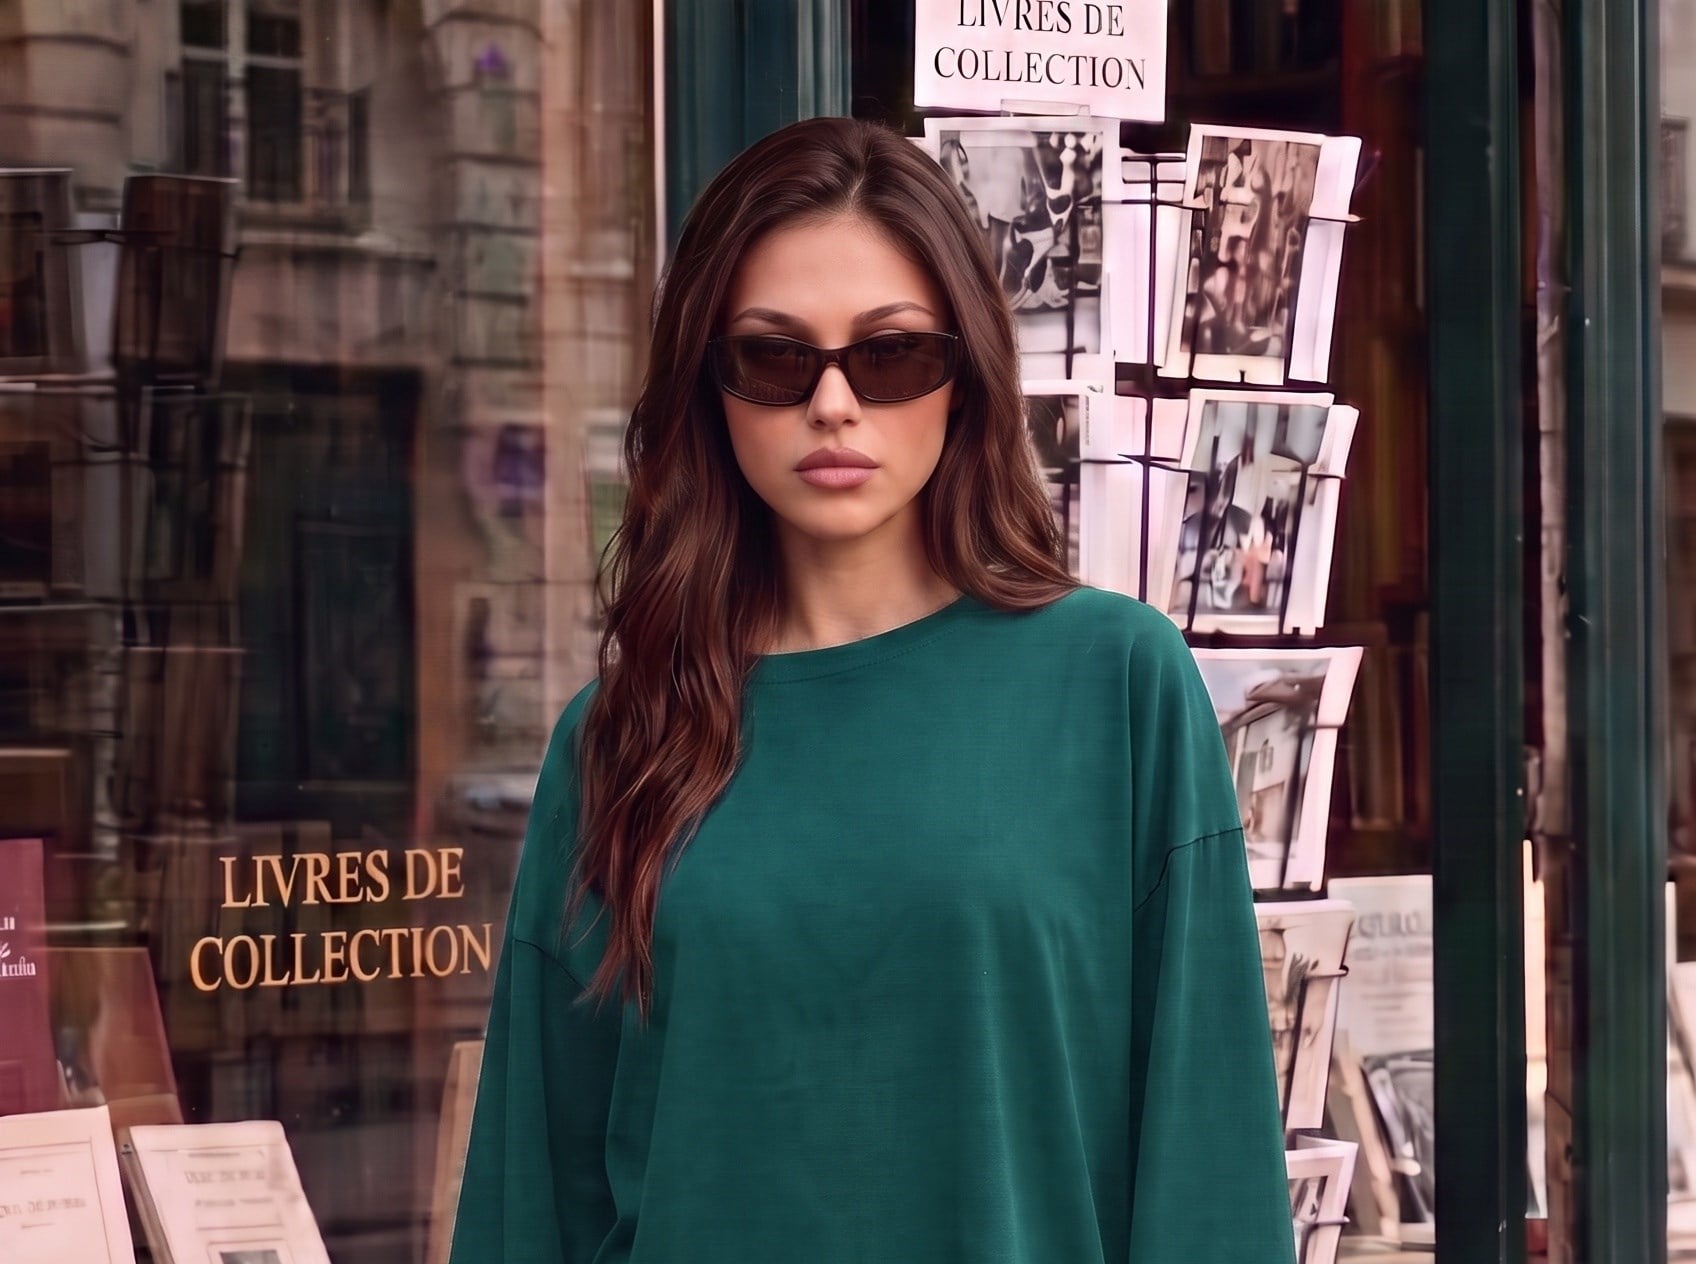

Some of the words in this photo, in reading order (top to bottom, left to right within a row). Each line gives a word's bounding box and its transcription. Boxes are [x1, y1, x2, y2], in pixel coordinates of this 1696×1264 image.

[957, 0, 1072, 34] LIVRES
[1084, 3, 1124, 37] DE
[934, 46, 1146, 90] COLLECTION
[219, 849, 391, 909] LIVRES
[402, 847, 465, 900] DE
[190, 923, 494, 992] COLLECTION
